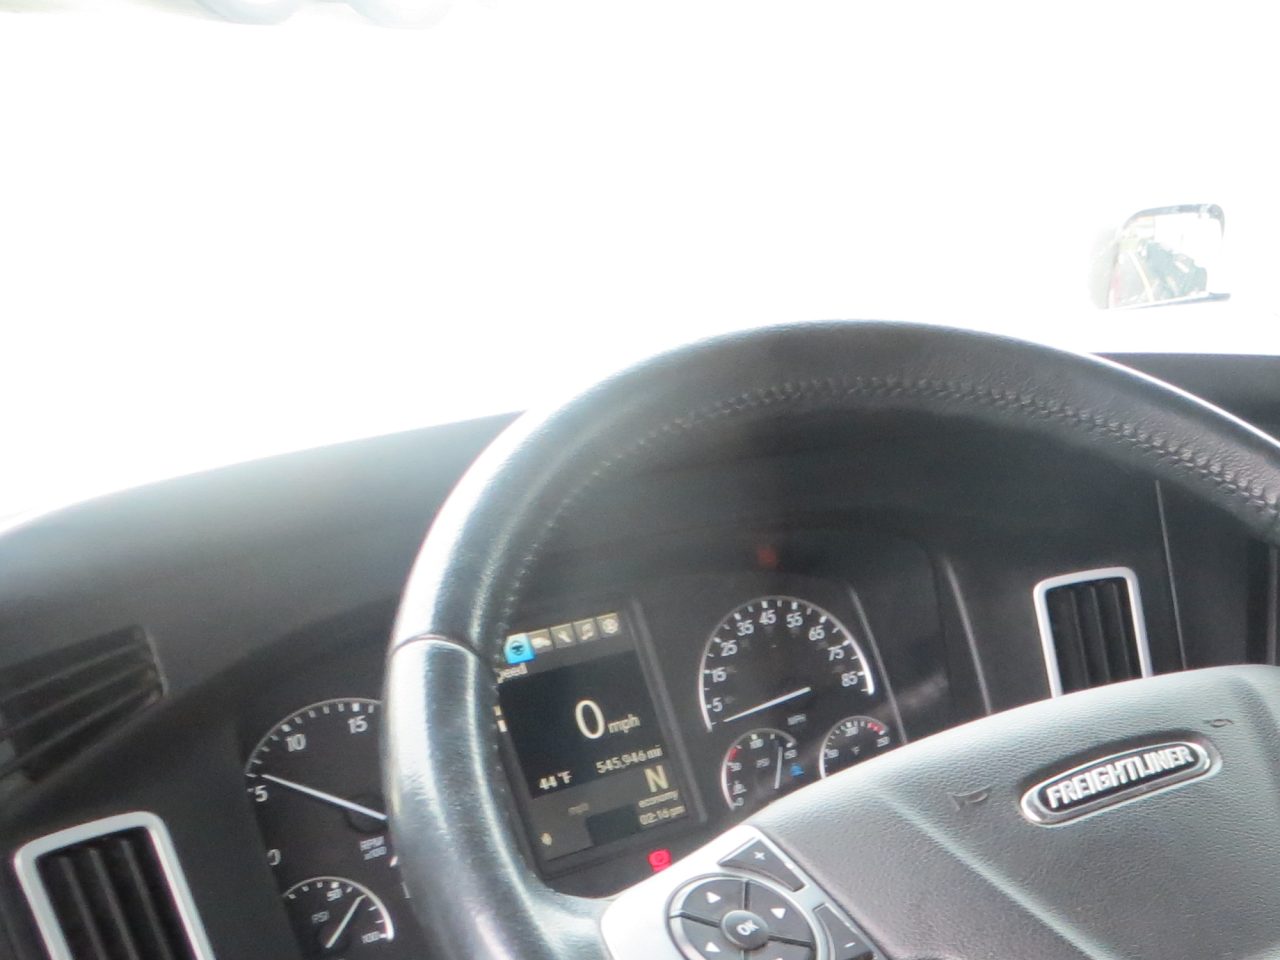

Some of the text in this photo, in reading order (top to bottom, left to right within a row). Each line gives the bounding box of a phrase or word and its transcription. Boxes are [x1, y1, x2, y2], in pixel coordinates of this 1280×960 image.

[759, 609, 777, 624] 45
[786, 611, 803, 628] 55
[736, 620, 754, 636] 35
[808, 625, 825, 641] 65
[720, 640, 738, 657] 25
[828, 645, 845, 661] 75
[711, 667, 727, 682] 15
[841, 671, 858, 687] 85
[712, 697, 723, 712] 5
[347, 715, 368, 734] 15
[575, 699, 641, 739] 0 mph
[285, 733, 306, 752] 10
[644, 765, 669, 793] N
[1045, 745, 1195, 810] FREIGHTLINER
[254, 784, 268, 802] 5
[736, 919, 760, 936] OK
